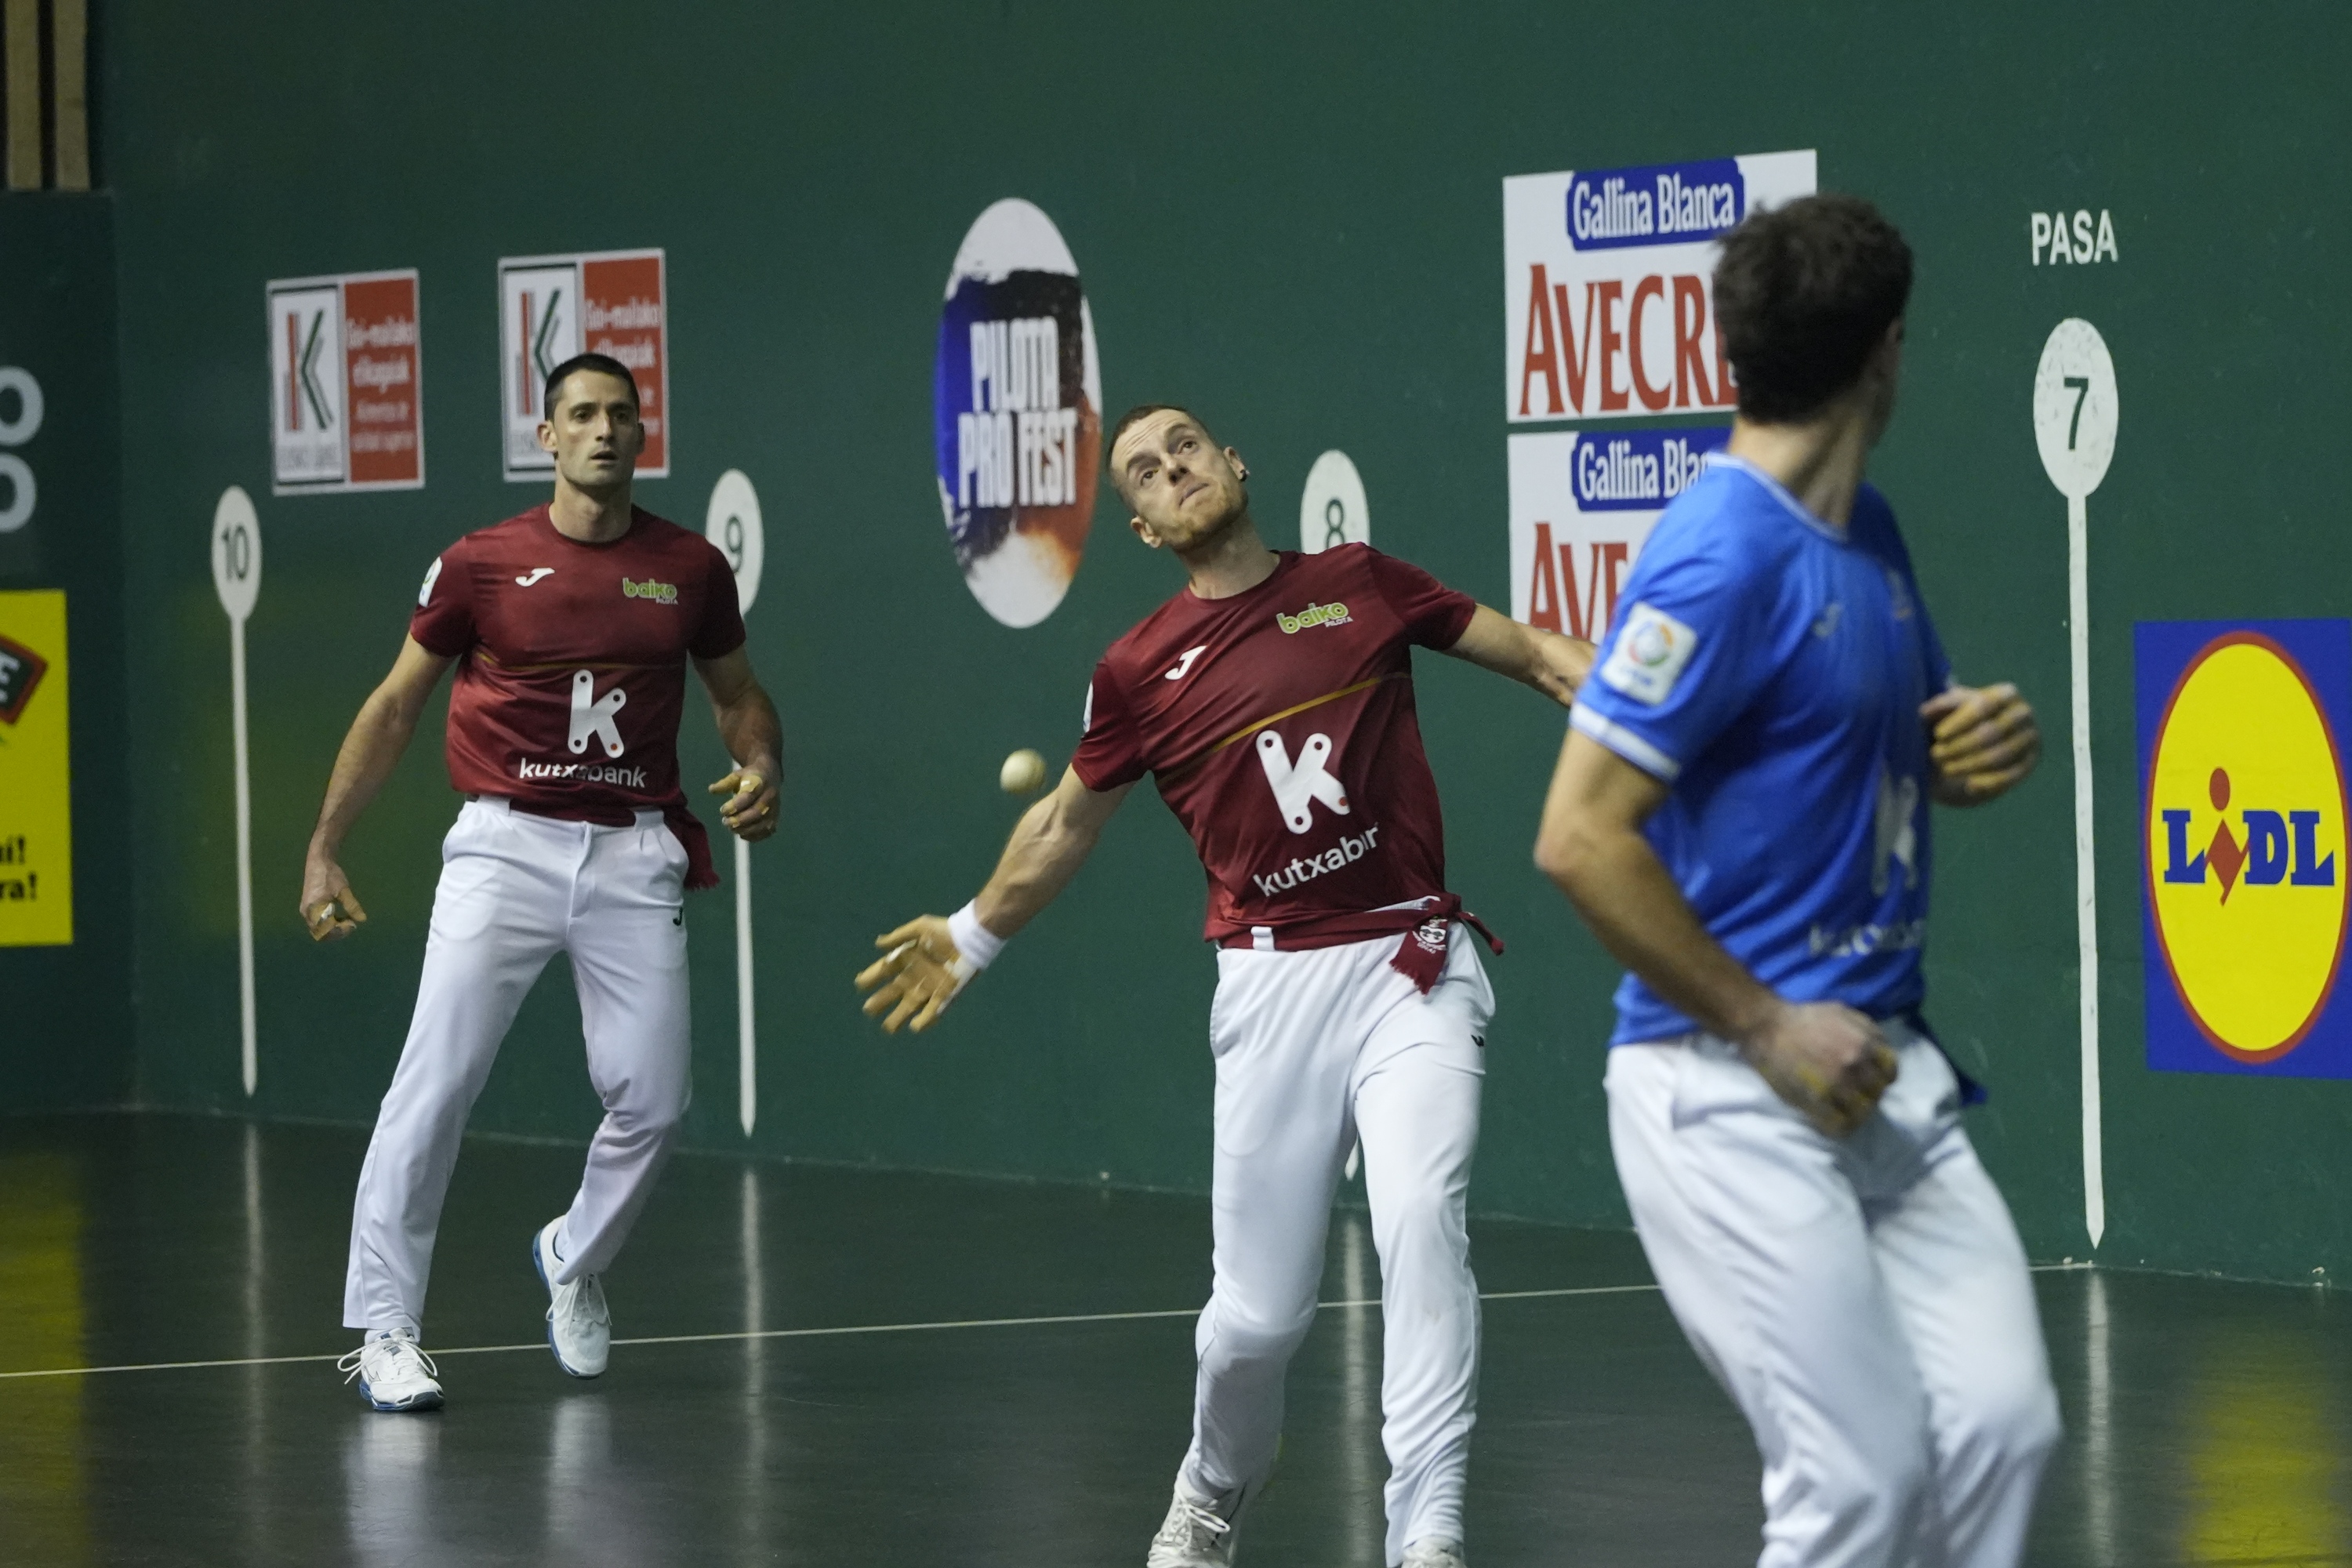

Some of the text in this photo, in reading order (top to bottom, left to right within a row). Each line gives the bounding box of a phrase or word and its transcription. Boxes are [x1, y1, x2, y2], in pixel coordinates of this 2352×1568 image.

[1573, 171, 1735, 240] Gallina Blanca
[2031, 209, 2118, 266] PASA
[2063, 376, 2089, 451] 7
[958, 407, 1078, 508] PRO FEST
[1579, 440, 1661, 501] Gallina
[222, 524, 250, 582] 10
[724, 514, 743, 575] 9
[1326, 498, 1345, 550] 8
[1276, 602, 1348, 633] baiko
